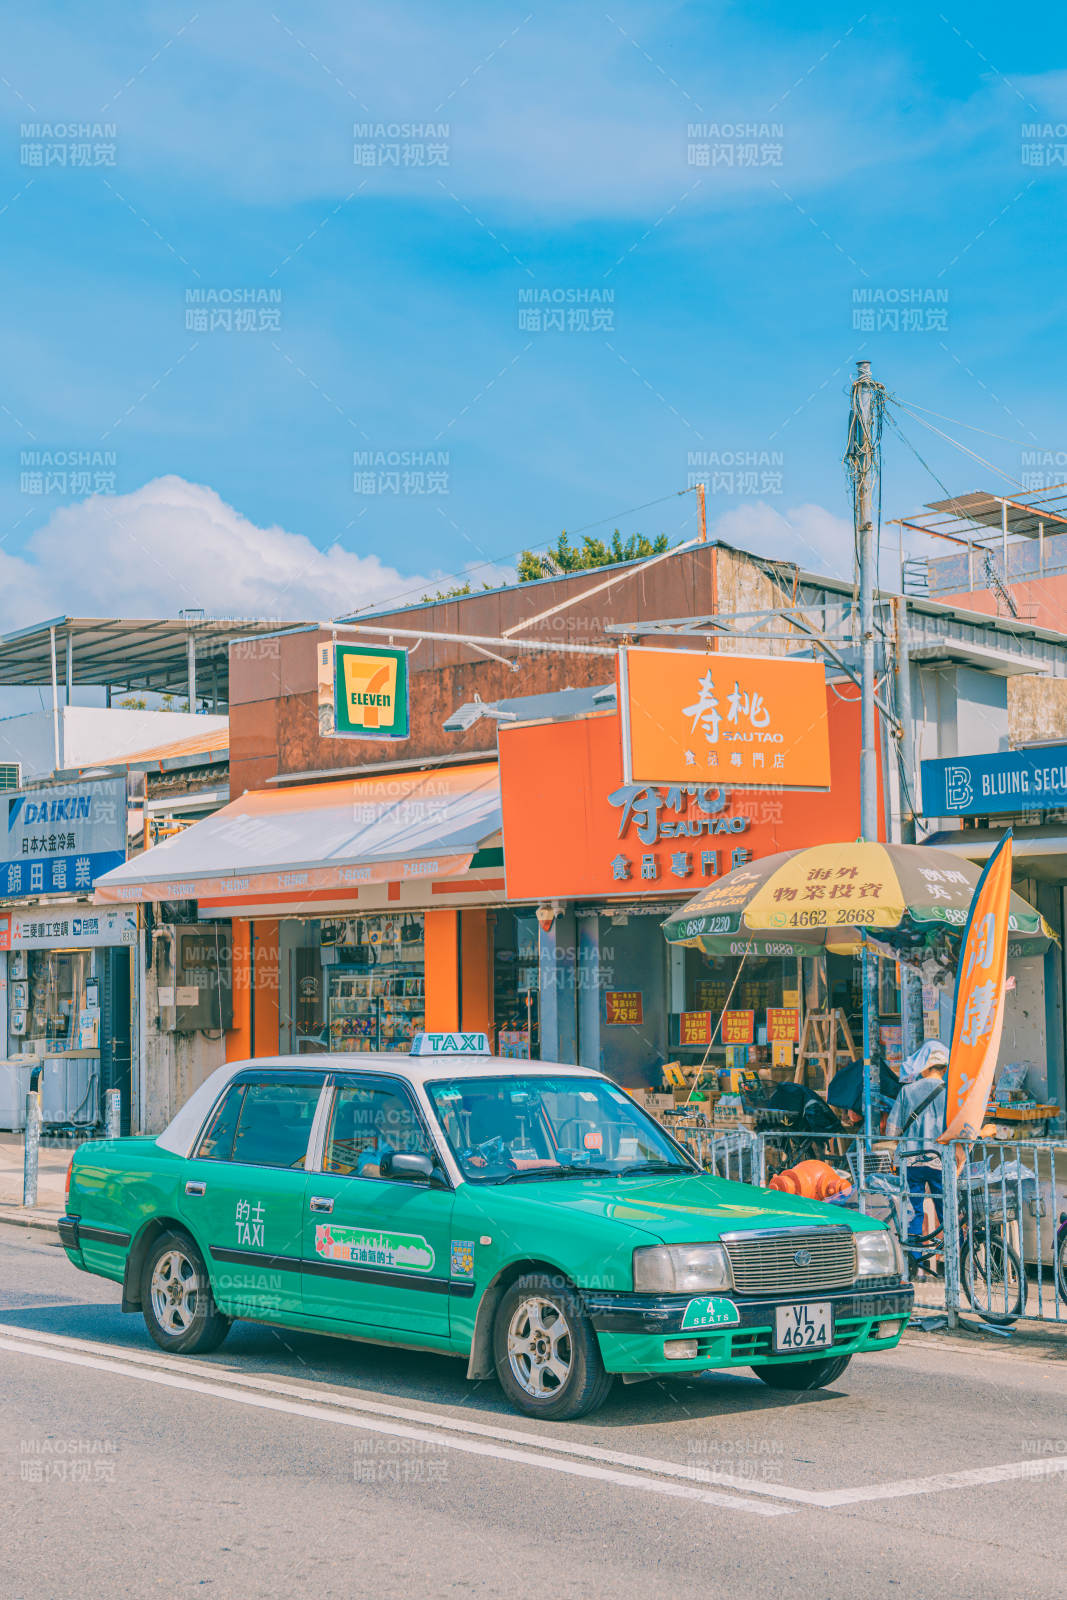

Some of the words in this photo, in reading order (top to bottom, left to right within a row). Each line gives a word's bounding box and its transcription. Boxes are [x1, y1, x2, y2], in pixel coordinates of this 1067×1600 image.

[722, 731, 784, 743] SAUTAO
[685, 750, 785, 768] 食品專門店
[982, 771, 1029, 796] BLUING
[24, 796, 91, 825] DAIKIN
[660, 816, 749, 838] SAUTAO
[22, 833, 76, 854] 日本大金冷氣
[8, 857, 91, 893] 錦田電業
[807, 866, 859, 881] 海外
[789, 910, 827, 927] 4662
[836, 908, 876, 924] 2668
[22, 920, 69, 938] 三菱重工空調
[428, 1034, 484, 1051] TAXI
[235, 1199, 266, 1224] 的士
[235, 1222, 265, 1247] TAXI
[706, 1301, 715, 1316] 4
[793, 1305, 814, 1326] VL
[693, 1314, 729, 1325] SEATS
[782, 1323, 826, 1348] 4624
